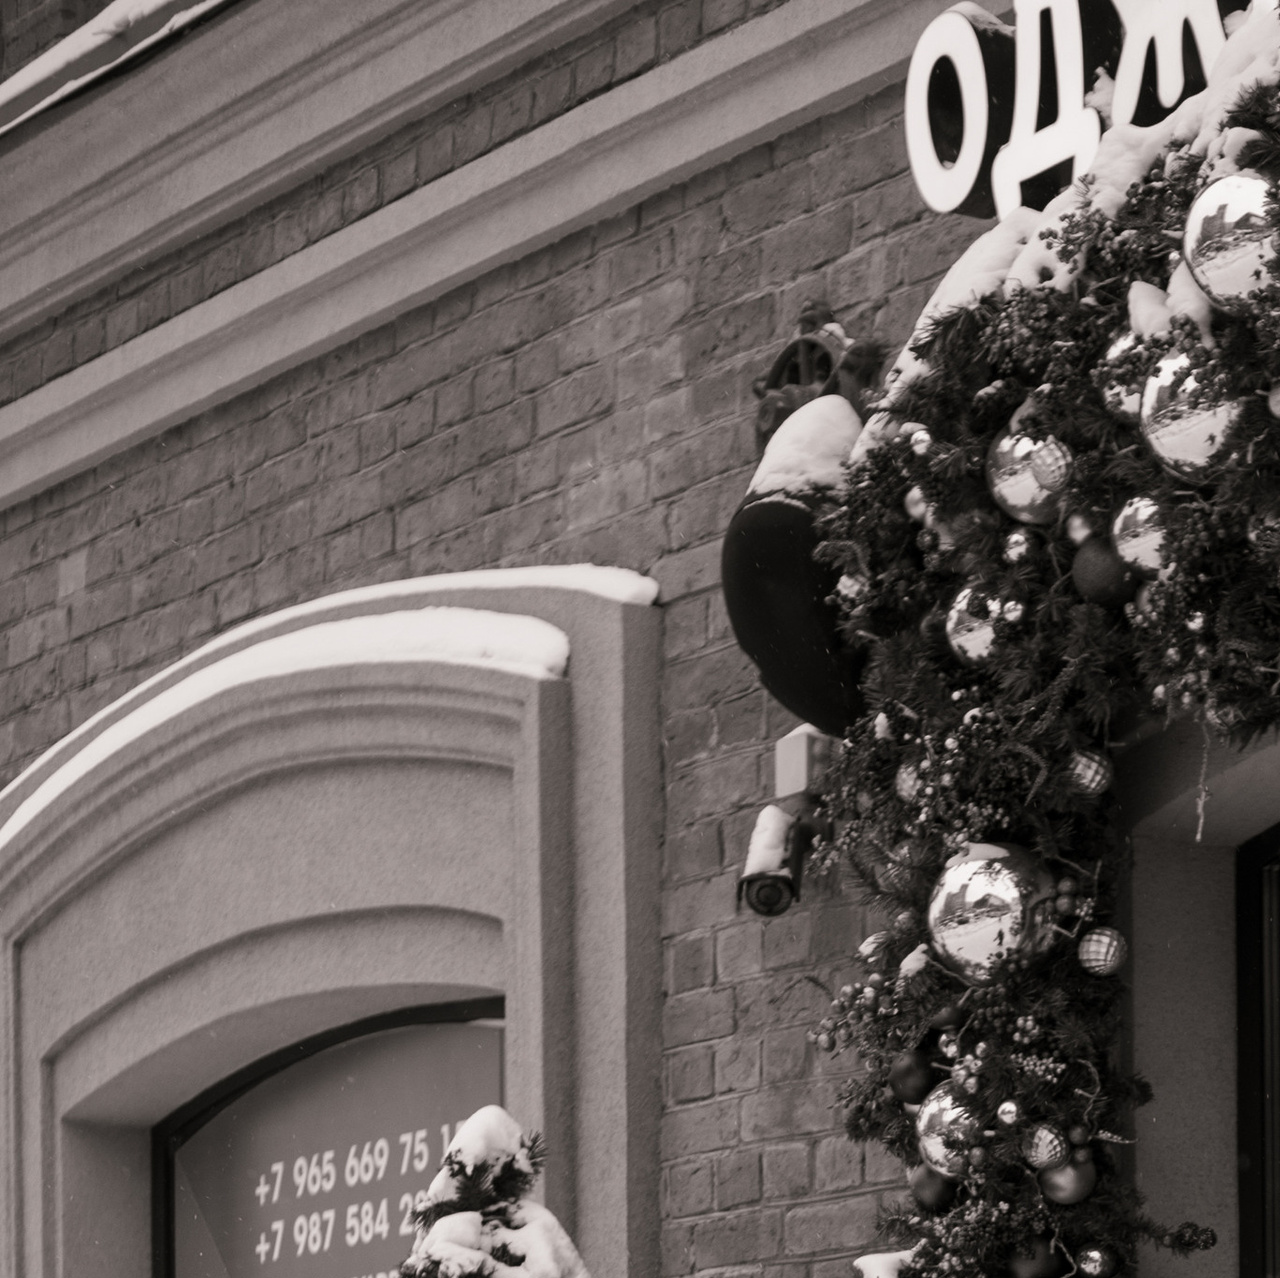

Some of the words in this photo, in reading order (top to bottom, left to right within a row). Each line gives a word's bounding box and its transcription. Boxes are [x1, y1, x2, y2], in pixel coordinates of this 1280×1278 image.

[255, 1161, 285, 1207] +7
[293, 1150, 336, 1199] 965
[344, 1137, 390, 1188] 669
[399, 1128, 430, 1176] 75
[255, 1219, 285, 1265] +7
[293, 1208, 336, 1258] 987
[344, 1198, 390, 1248] 584
